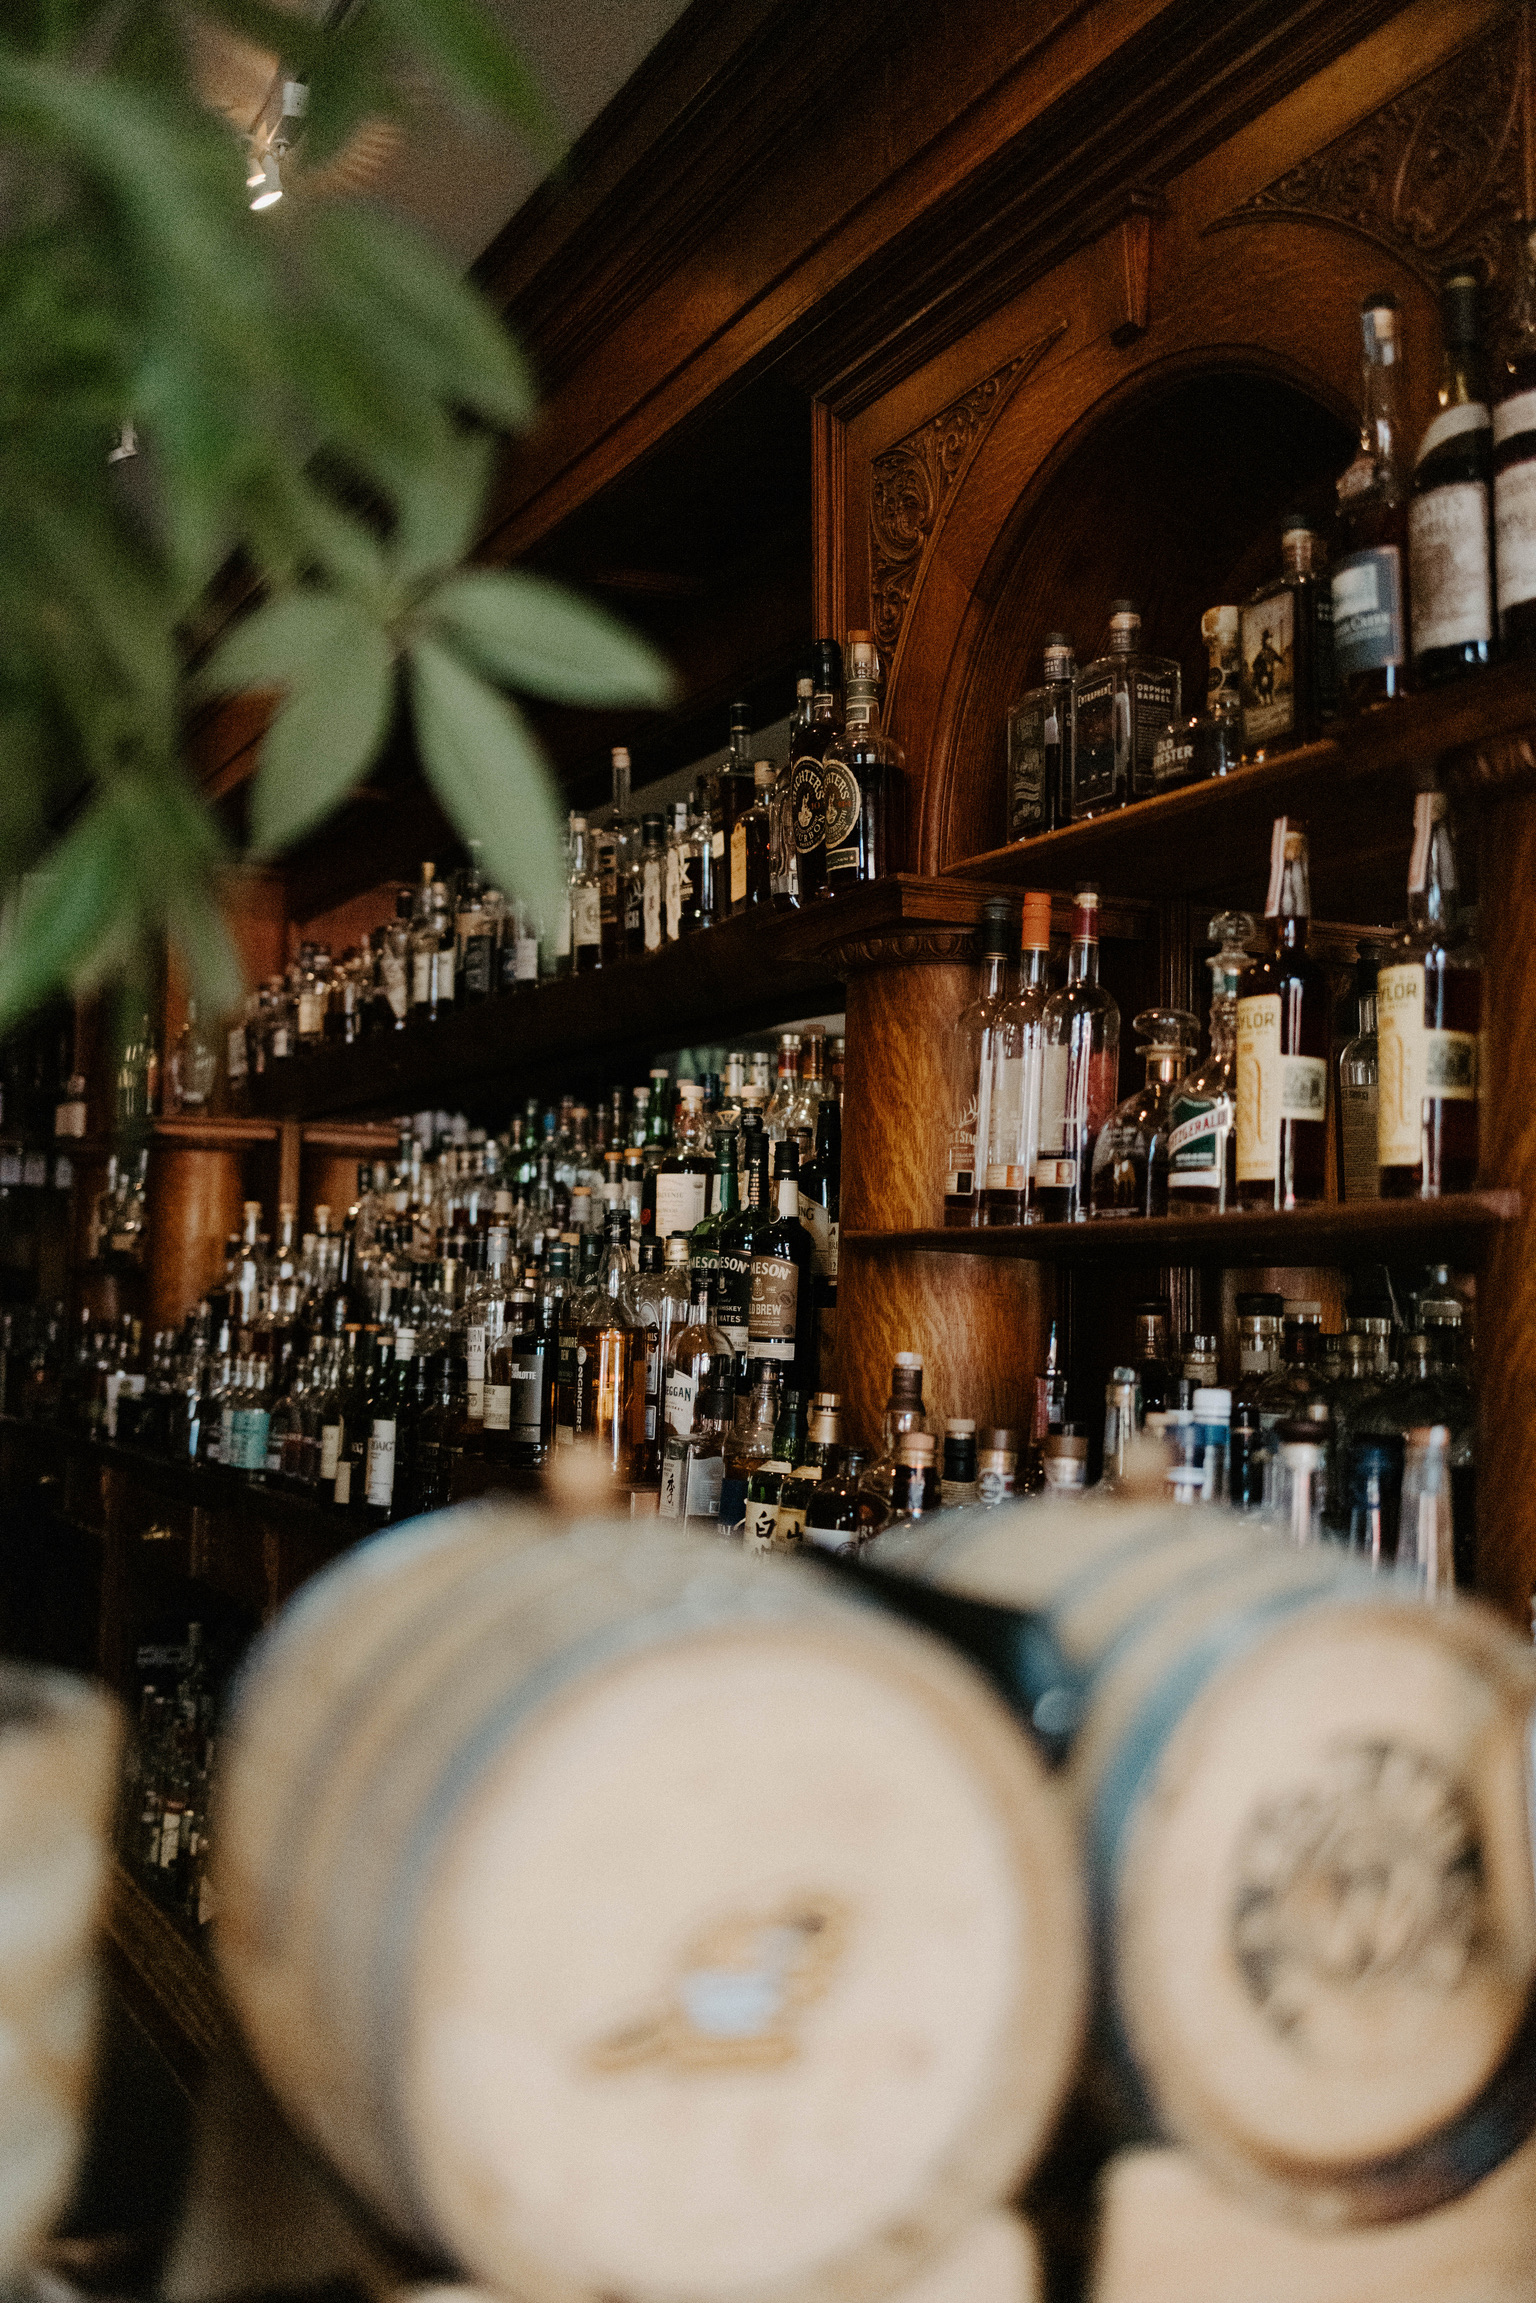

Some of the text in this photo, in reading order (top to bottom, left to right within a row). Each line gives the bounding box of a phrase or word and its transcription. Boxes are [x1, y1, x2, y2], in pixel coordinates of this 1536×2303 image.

[1136, 691, 1171, 703] BARREL
[825, 771, 851, 800] HTER'S
[756, 1303, 782, 1316] BREW
